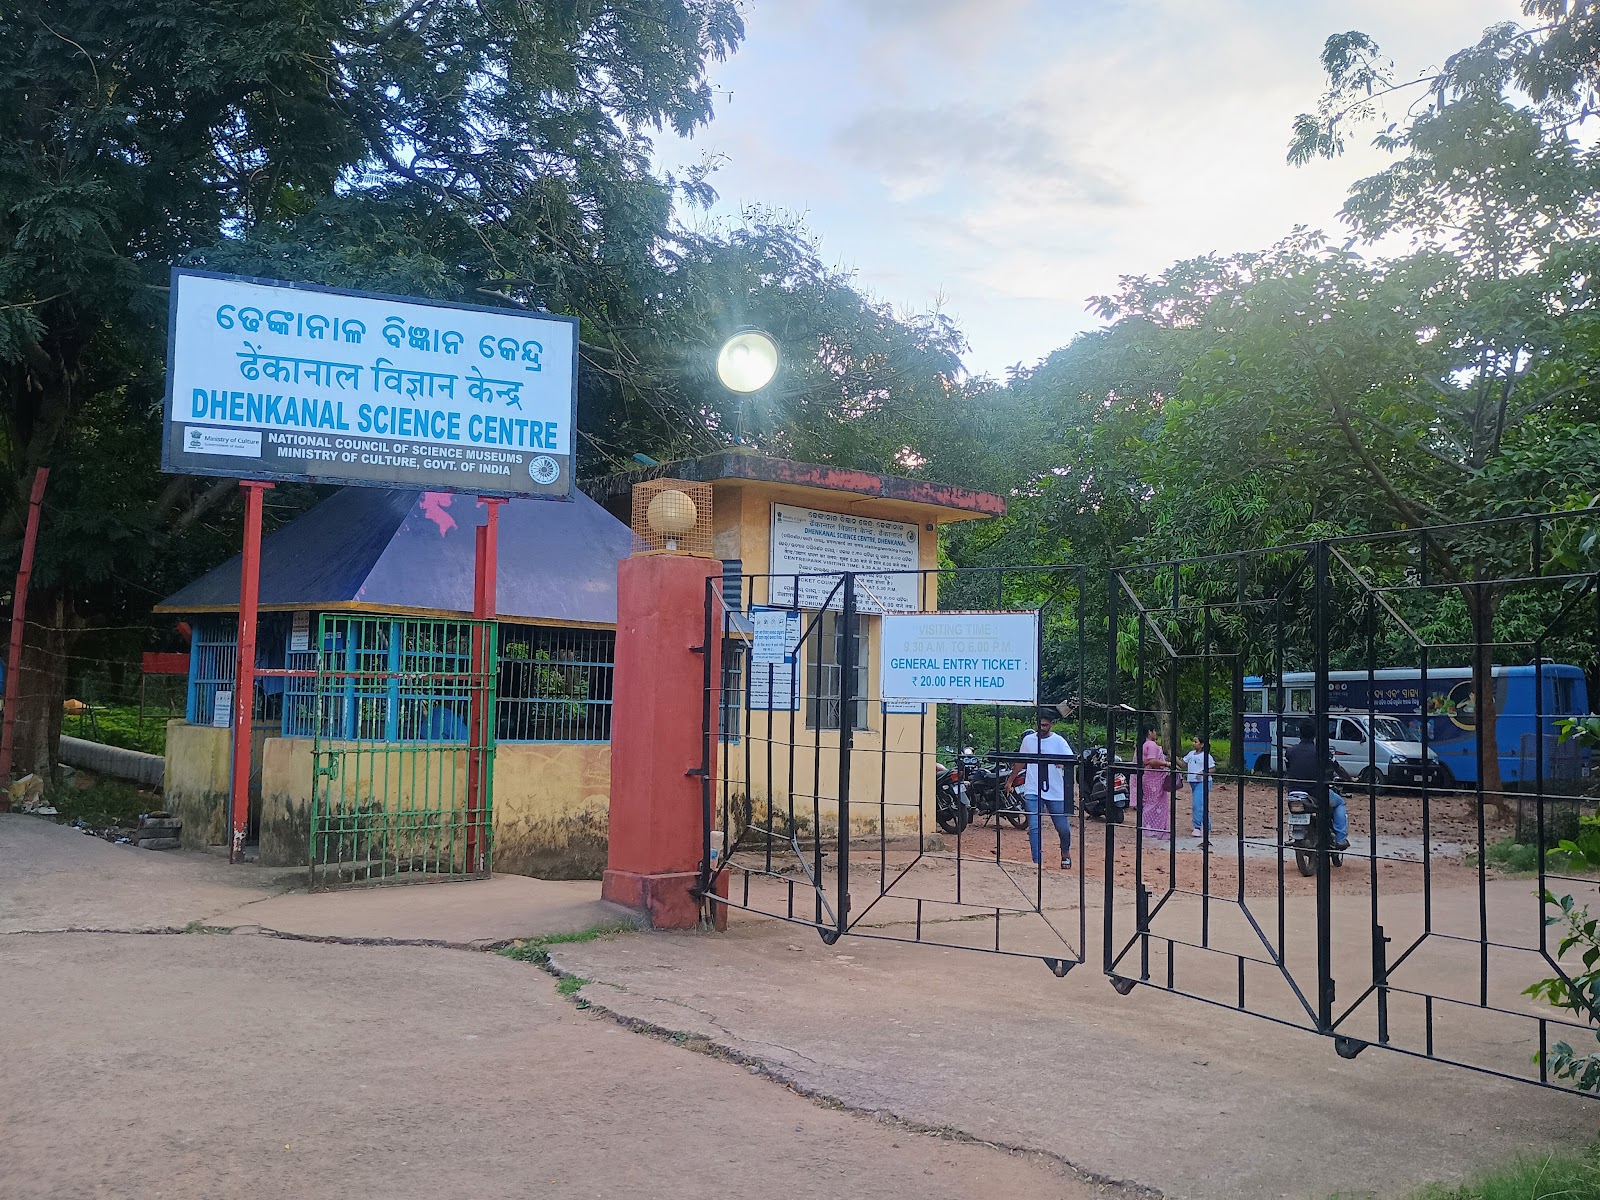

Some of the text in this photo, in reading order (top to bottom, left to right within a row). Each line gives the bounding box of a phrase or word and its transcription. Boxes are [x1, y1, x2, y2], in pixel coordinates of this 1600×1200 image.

[216, 304, 543, 372] ଢେଙ୍କାନାଳ ବିଜ୍ଞାନ କେନ୍ଦ୍ର
[236, 341, 524, 410] ढेंकानाल विज्ञान केन्द्र
[192, 388, 558, 449] DHENKANAL SCIENCE CENTRE
[268, 432, 523, 464] NATIONAL COUNCIL OF SCIENCE MUSEUMS
[277, 446, 511, 475] MINISTRY OF CULTURE, GOVT. OF INDIA
[804, 528, 906, 547] DHENKANAL SCIENCE CENTRE, DHENKANAL
[919, 624, 962, 635] VISITING
[967, 624, 992, 635] TIME
[904, 642, 1013, 653] 9.30 A.M. TO 6.00 P.M.
[890, 658, 940, 669] GENERAL
[943, 659, 978, 670] ENTRY
[982, 659, 1021, 670] TICKET
[920, 676, 946, 686] 20.00
[950, 676, 971, 687] PER
[974, 677, 1005, 687] HEAD
